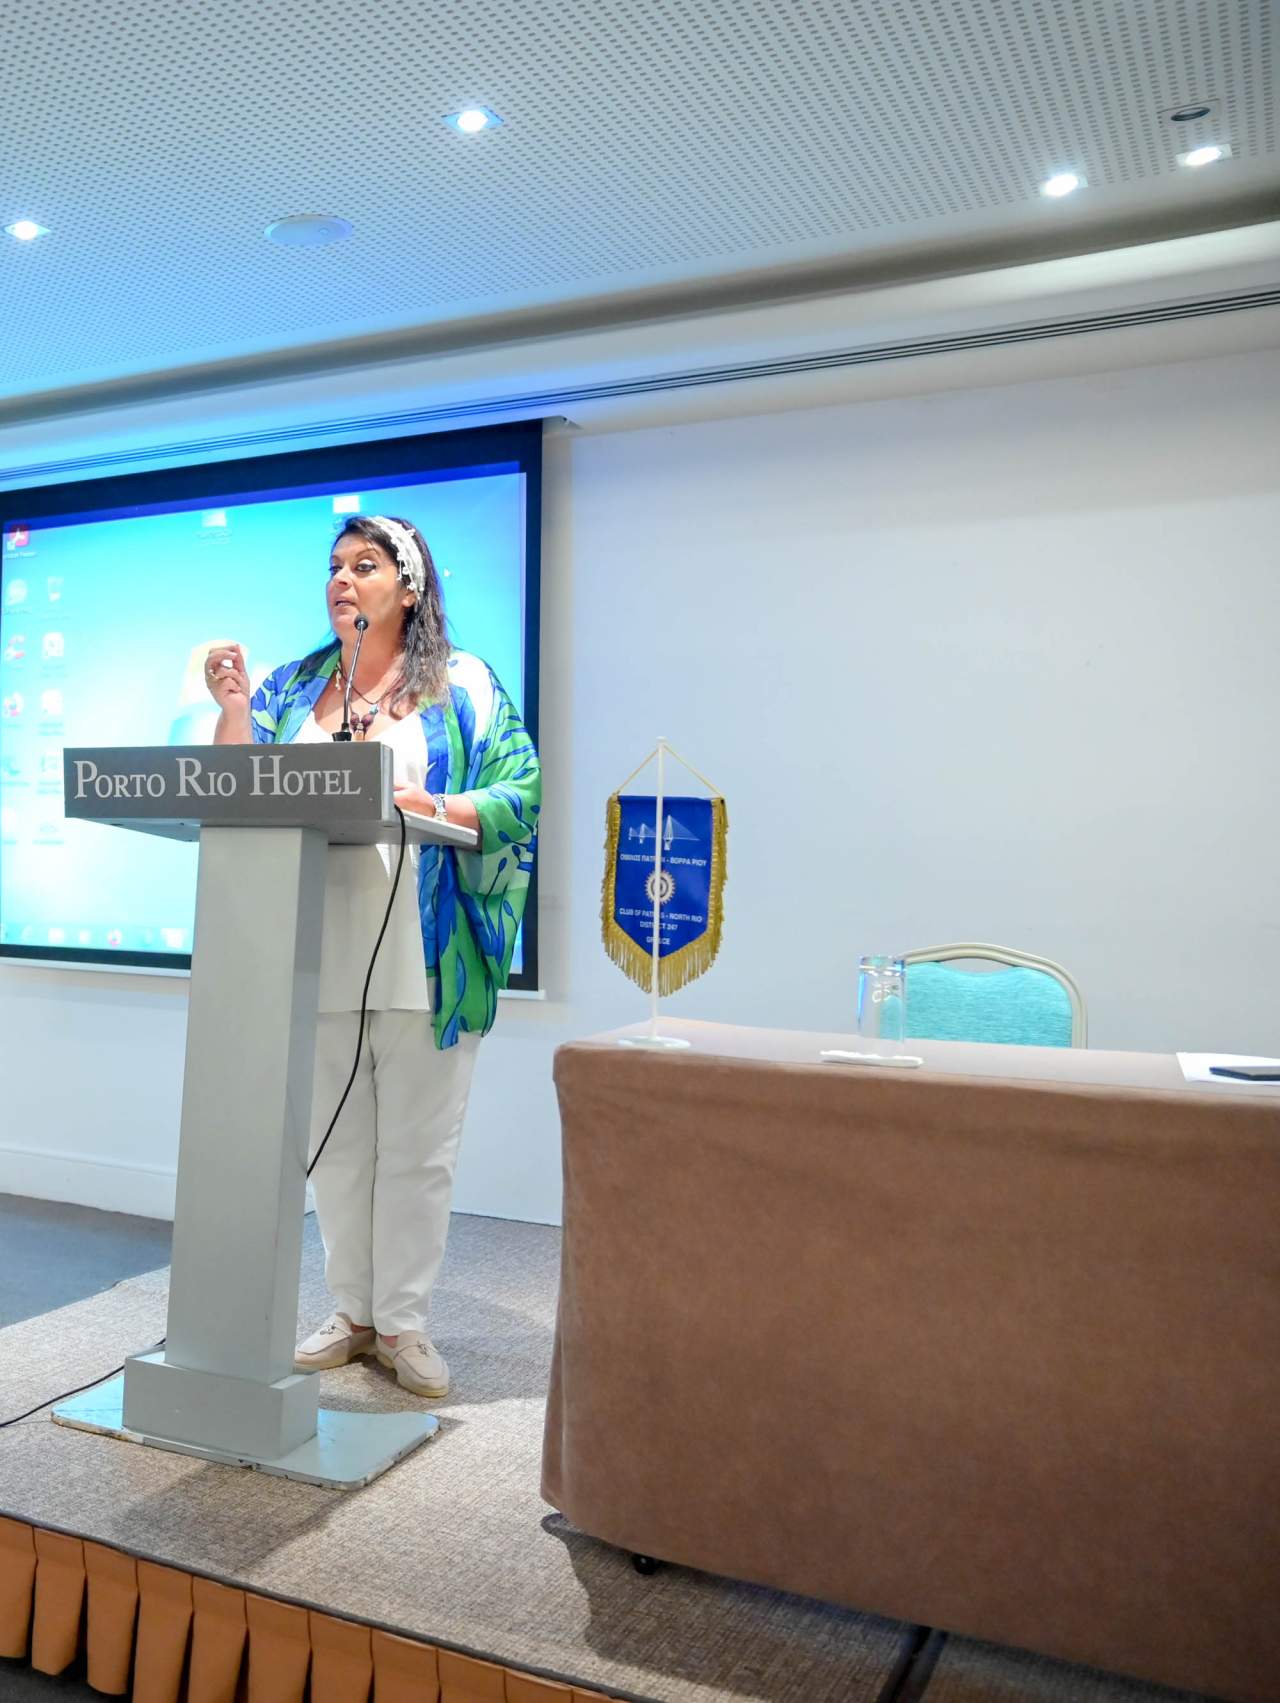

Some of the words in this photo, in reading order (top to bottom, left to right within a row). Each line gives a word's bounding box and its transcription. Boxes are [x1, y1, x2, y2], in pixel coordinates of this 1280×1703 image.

[73, 760, 166, 799] PORTO
[175, 757, 237, 797] RIO
[249, 755, 361, 796] HOTEL
